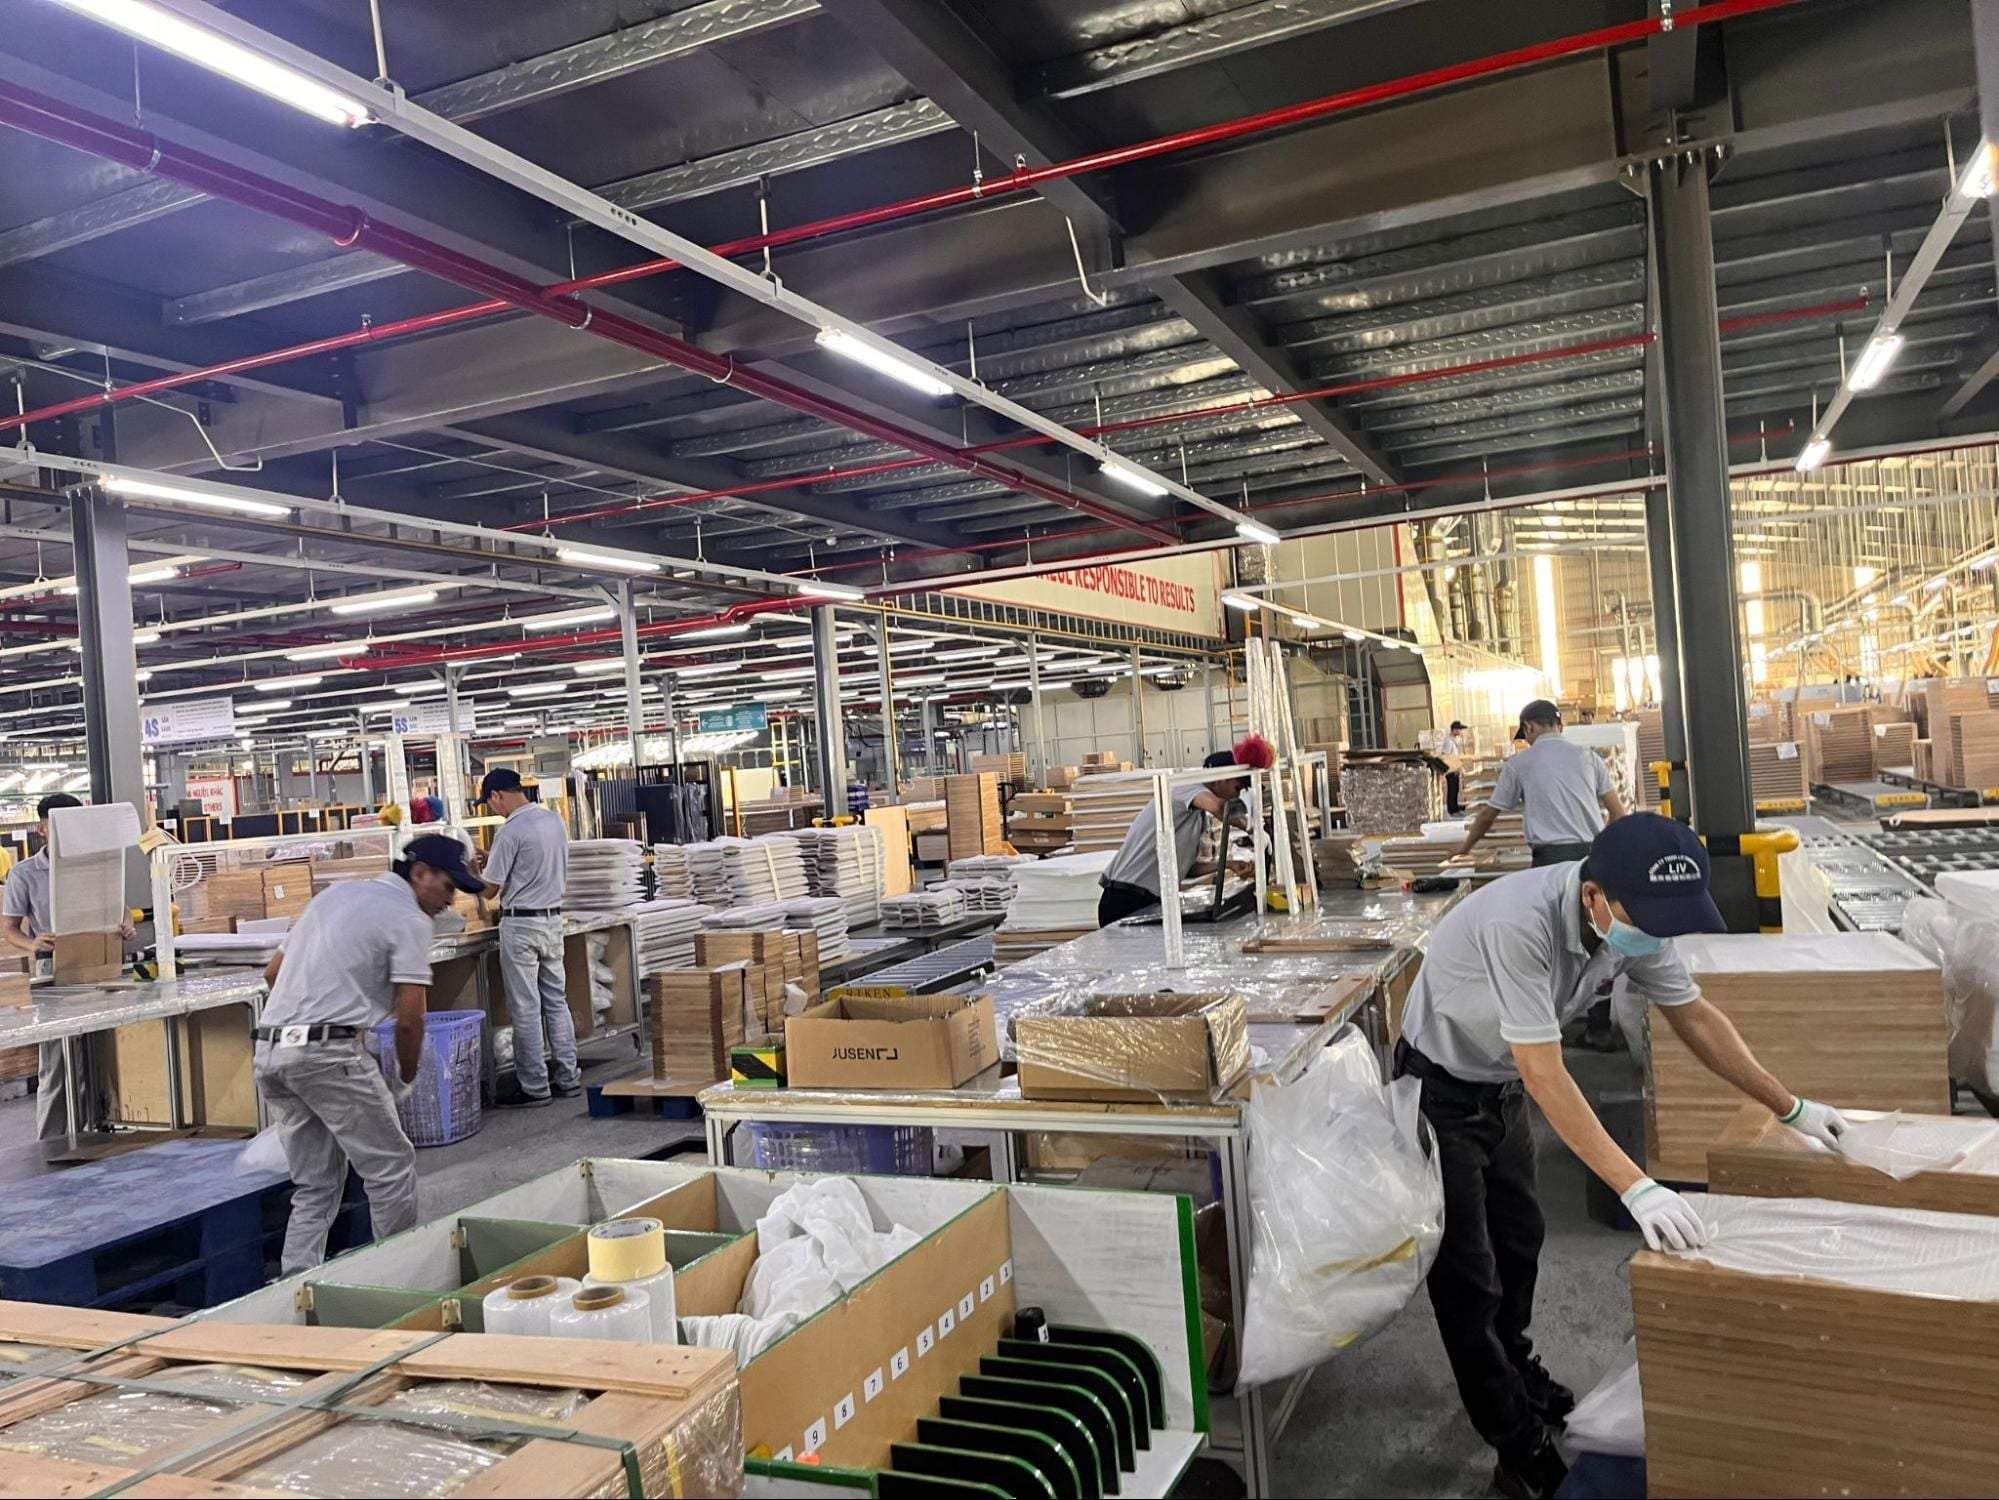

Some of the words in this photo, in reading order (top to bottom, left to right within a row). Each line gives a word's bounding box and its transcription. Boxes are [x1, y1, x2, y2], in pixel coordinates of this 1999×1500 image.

[1075, 566, 1146, 602] RESPONSIBLE
[1146, 576, 1159, 606] TO
[1160, 581, 1196, 613] RESULTS
[1004, 1267, 1009, 1278] 1
[985, 1284, 990, 1295] 2
[965, 1301, 969, 1312] 3
[945, 1318, 949, 1329] 4
[923, 1336, 928, 1348] 5
[897, 1357, 903, 1370] 6
[871, 1379, 876, 1392] 7
[842, 1404, 847, 1418] 8
[813, 1430, 818, 1445] 9
